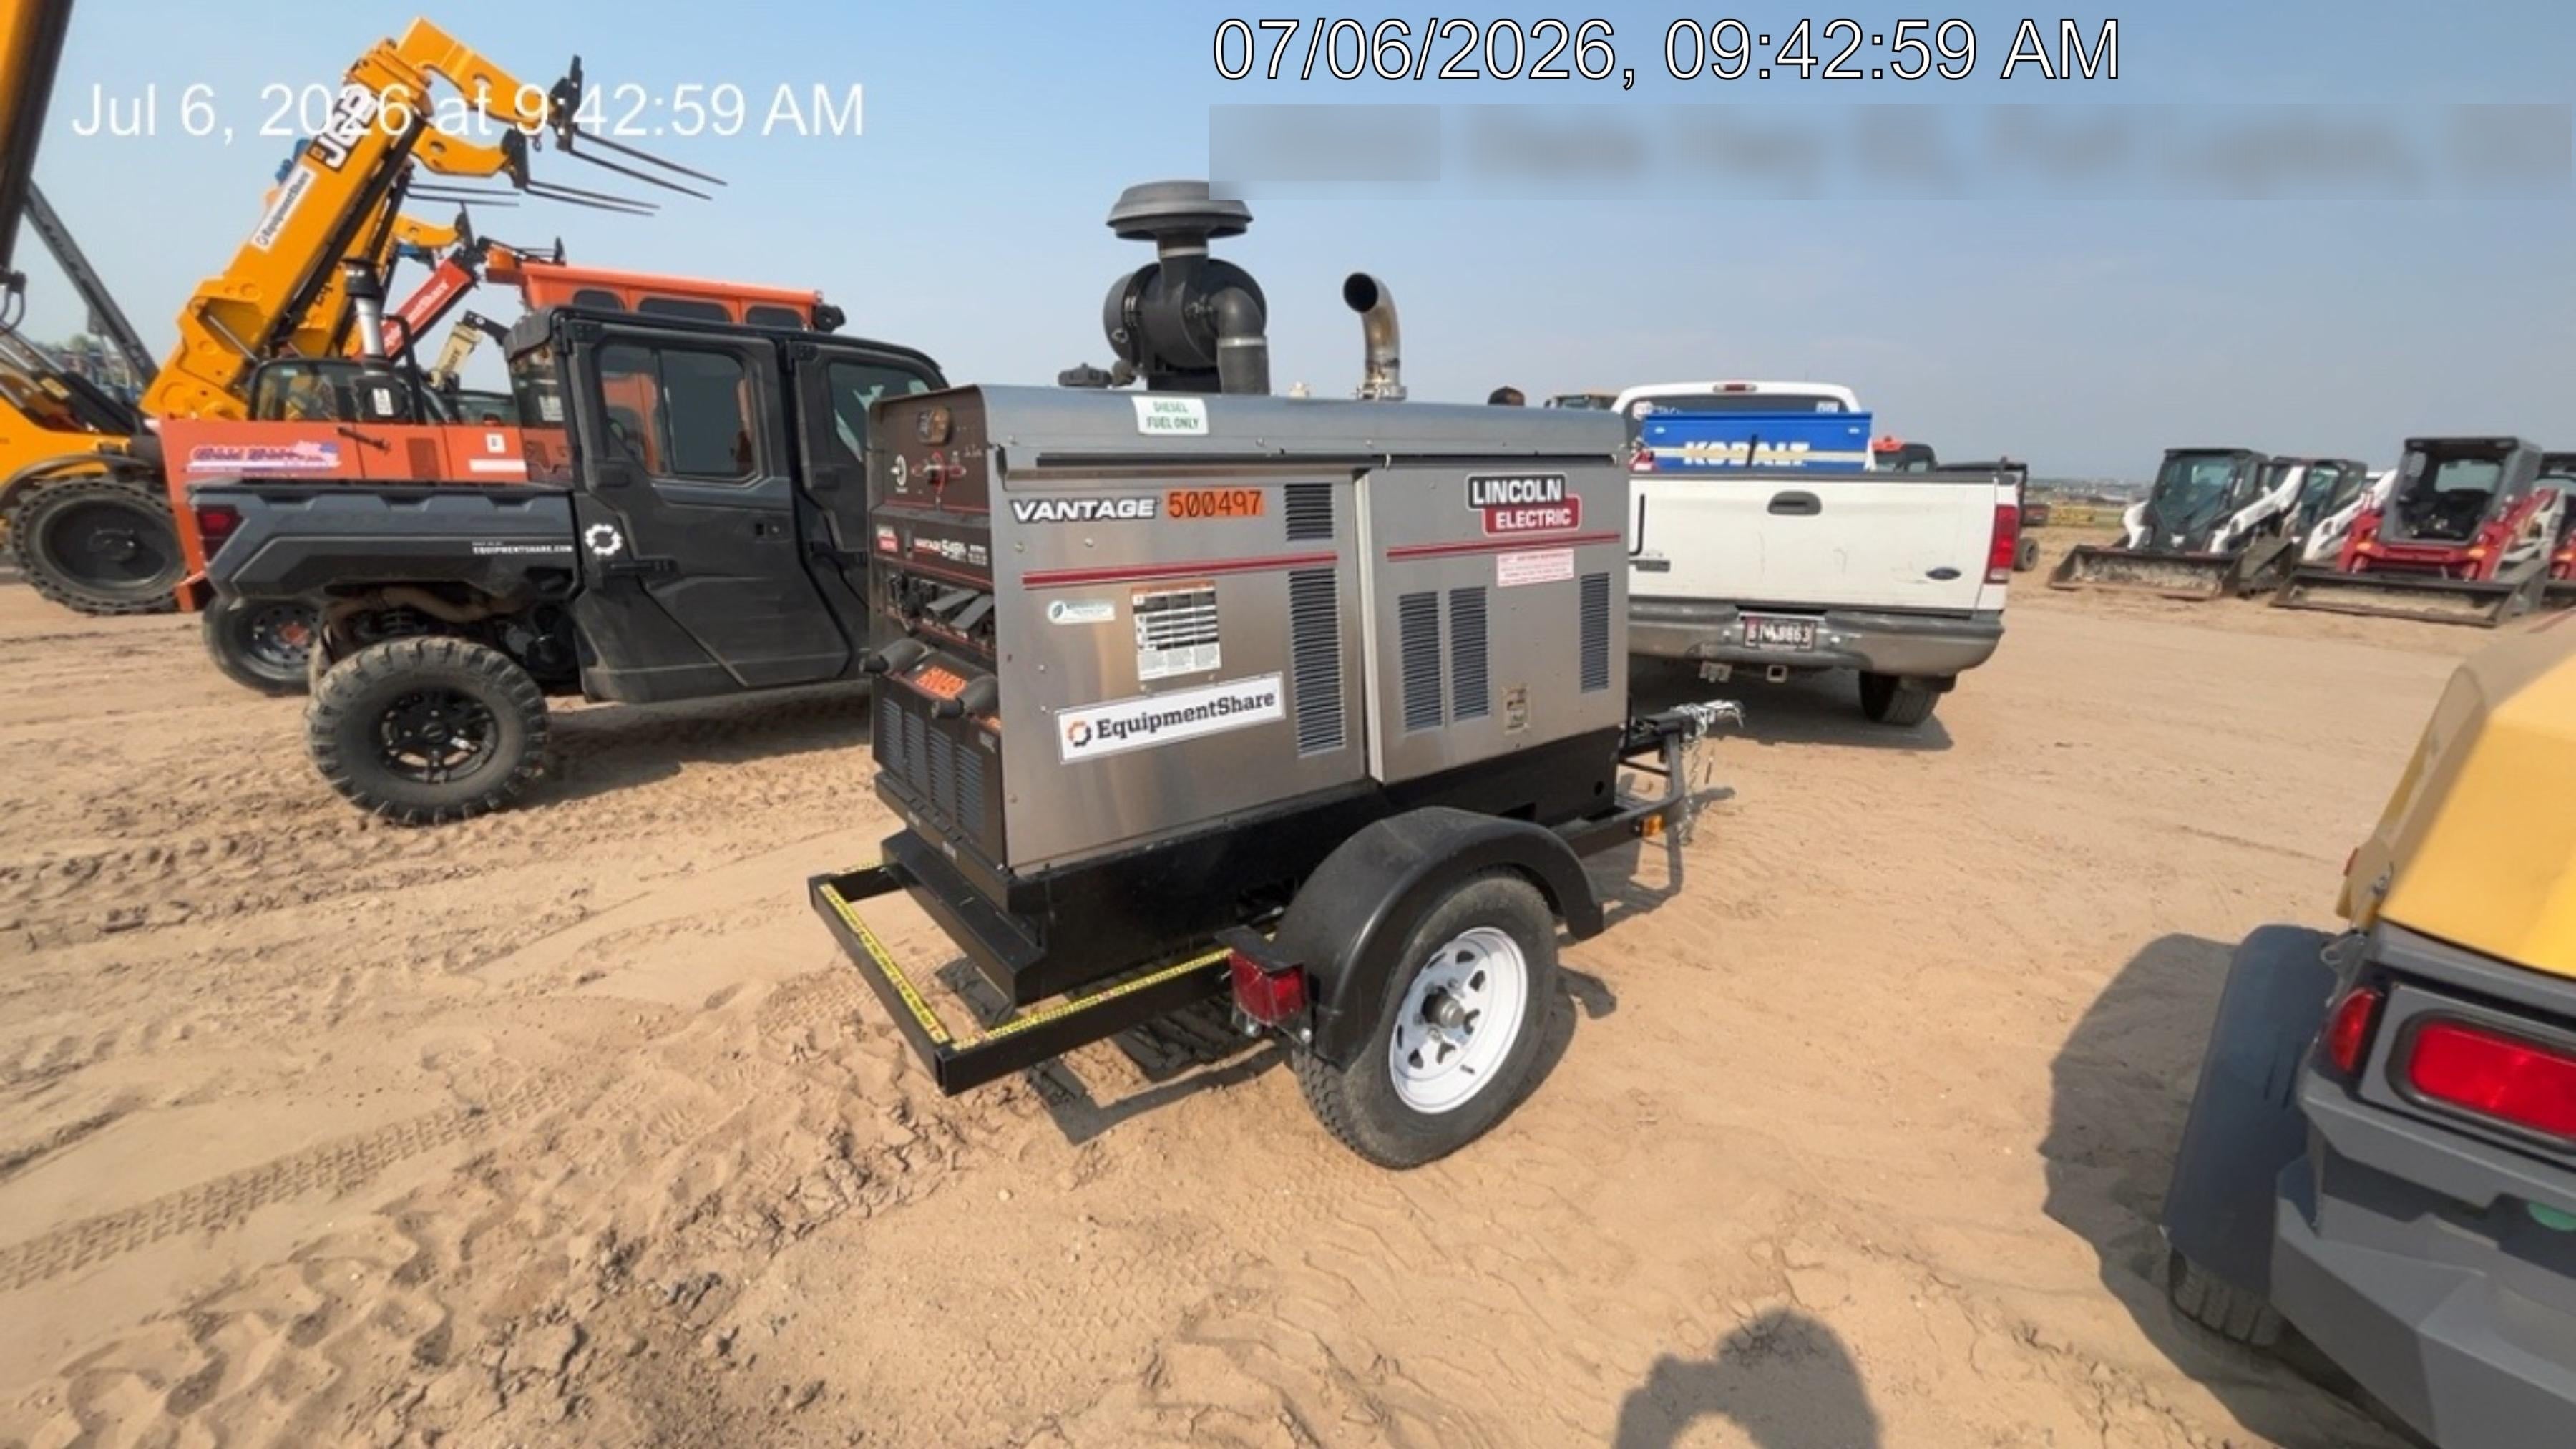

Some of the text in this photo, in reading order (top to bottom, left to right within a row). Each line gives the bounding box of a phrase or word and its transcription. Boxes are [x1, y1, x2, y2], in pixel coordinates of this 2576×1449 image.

[1152, 401, 1188, 413] DIESEL
[1146, 416, 1199, 429] FUEL ONLY
[1684, 442, 1810, 467] KOBALT
[1169, 490, 1262, 518] 500497
[1473, 479, 1562, 505] LINCOLN
[1010, 498, 1156, 522] VANTAGE
[1495, 508, 1572, 530] ELECTRIC
[1096, 691, 1275, 740] EquipmentShare
